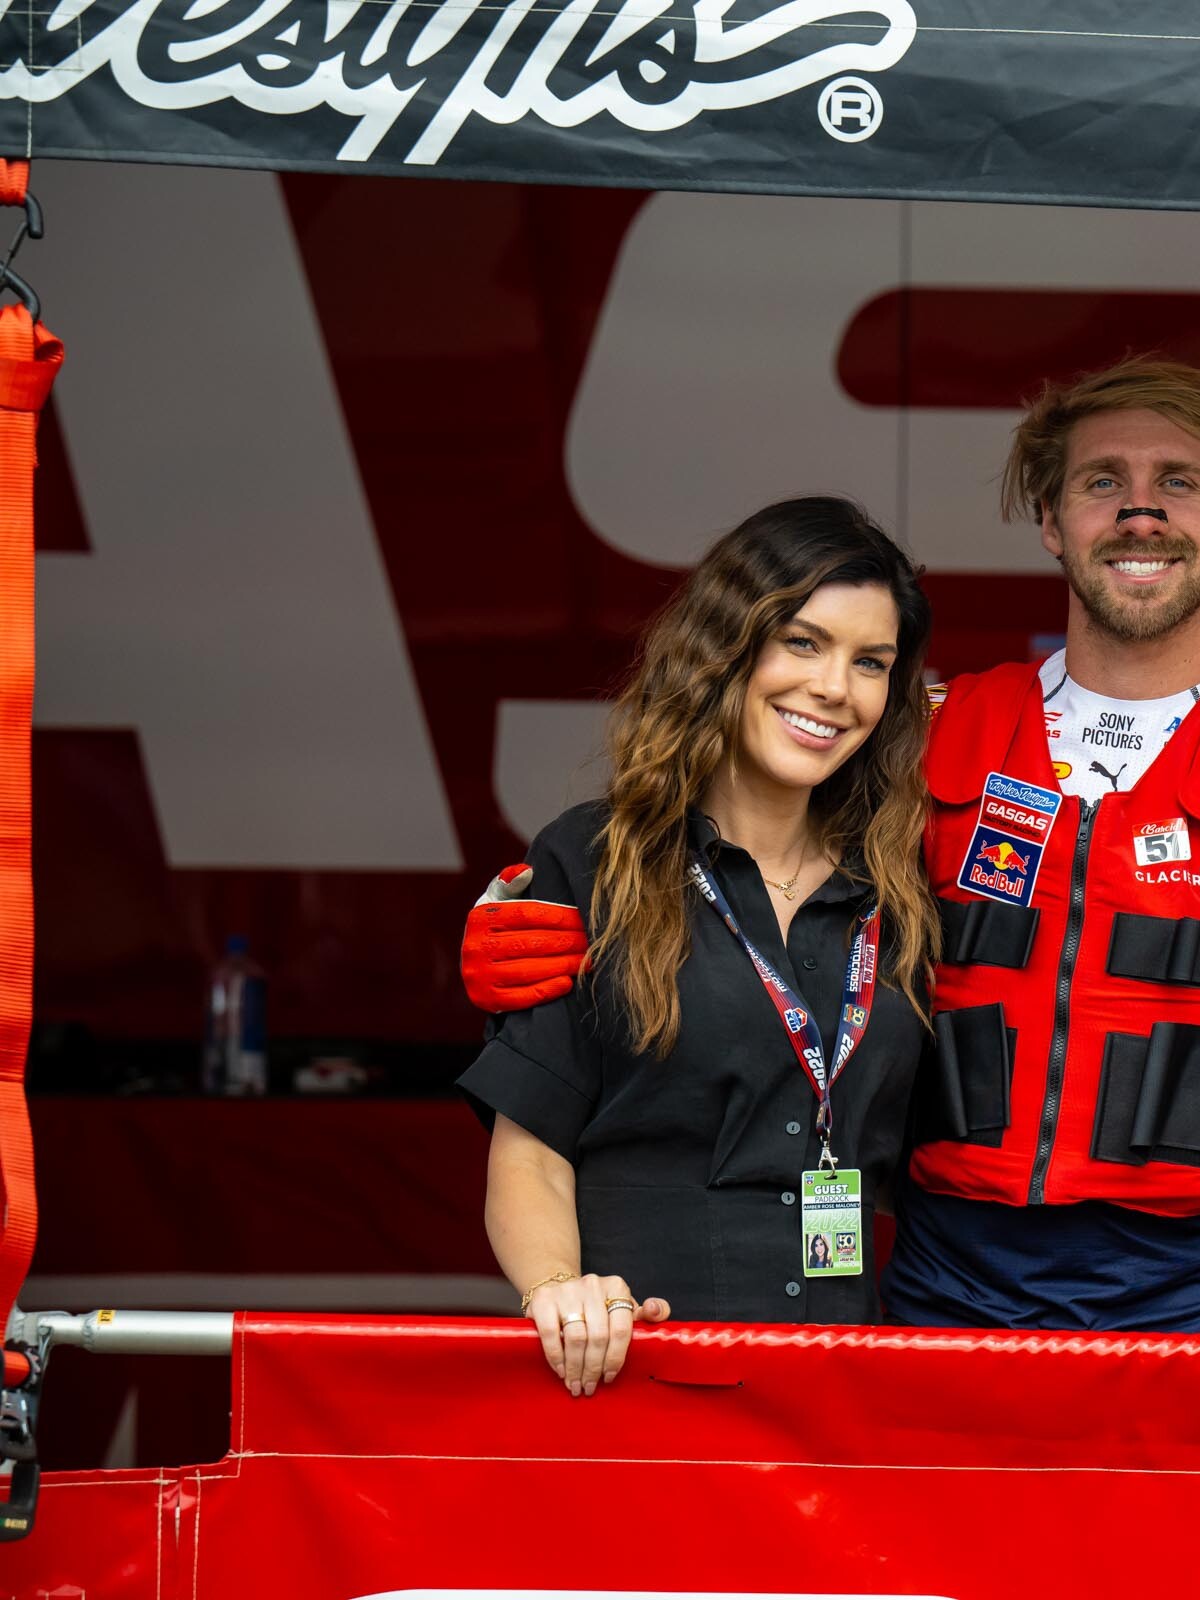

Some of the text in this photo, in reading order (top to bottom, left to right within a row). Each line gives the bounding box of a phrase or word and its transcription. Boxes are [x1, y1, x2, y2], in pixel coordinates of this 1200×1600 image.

[1098, 712, 1135, 732] SONY
[1081, 727, 1144, 751] PICTURES
[986, 801, 1049, 831] GASGAS
[1144, 832, 1181, 863] 51
[969, 863, 1026, 898] Red Bull
[814, 1184, 849, 1195] GUEST
[814, 1195, 850, 1203] PADDOCK
[838, 1234, 854, 1247] 50
